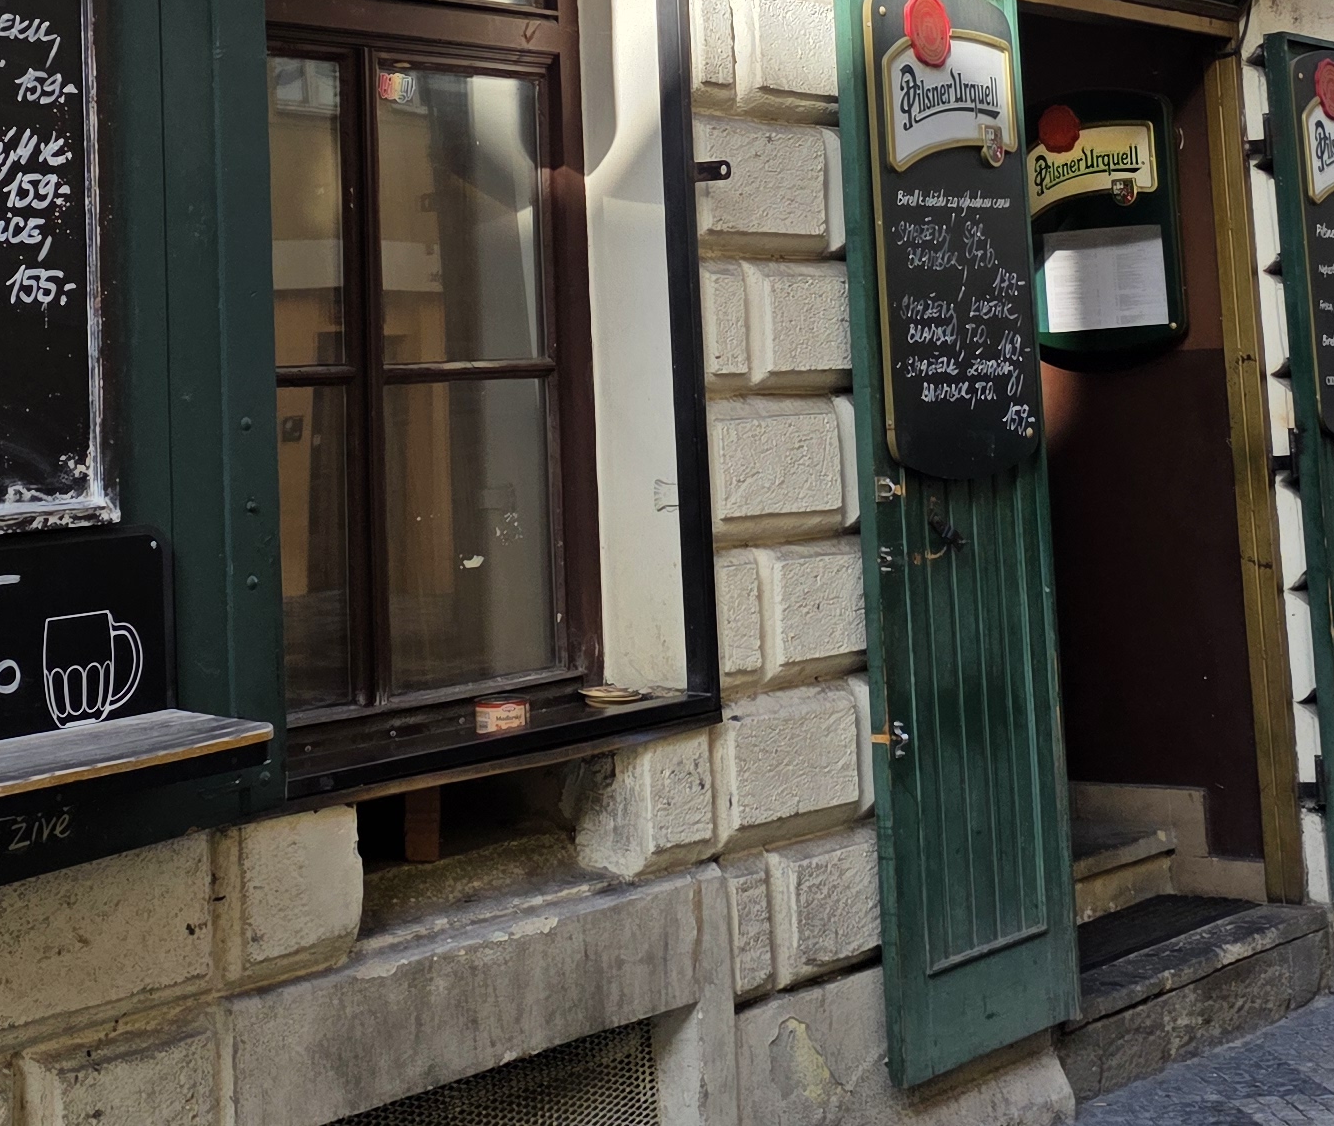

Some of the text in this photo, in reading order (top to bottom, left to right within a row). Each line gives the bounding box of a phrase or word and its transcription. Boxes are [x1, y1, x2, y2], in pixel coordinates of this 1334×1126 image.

[899, 63, 999, 132] Pilsner Urquell
[1034, 145, 1140, 197] Pilsner Urquell
